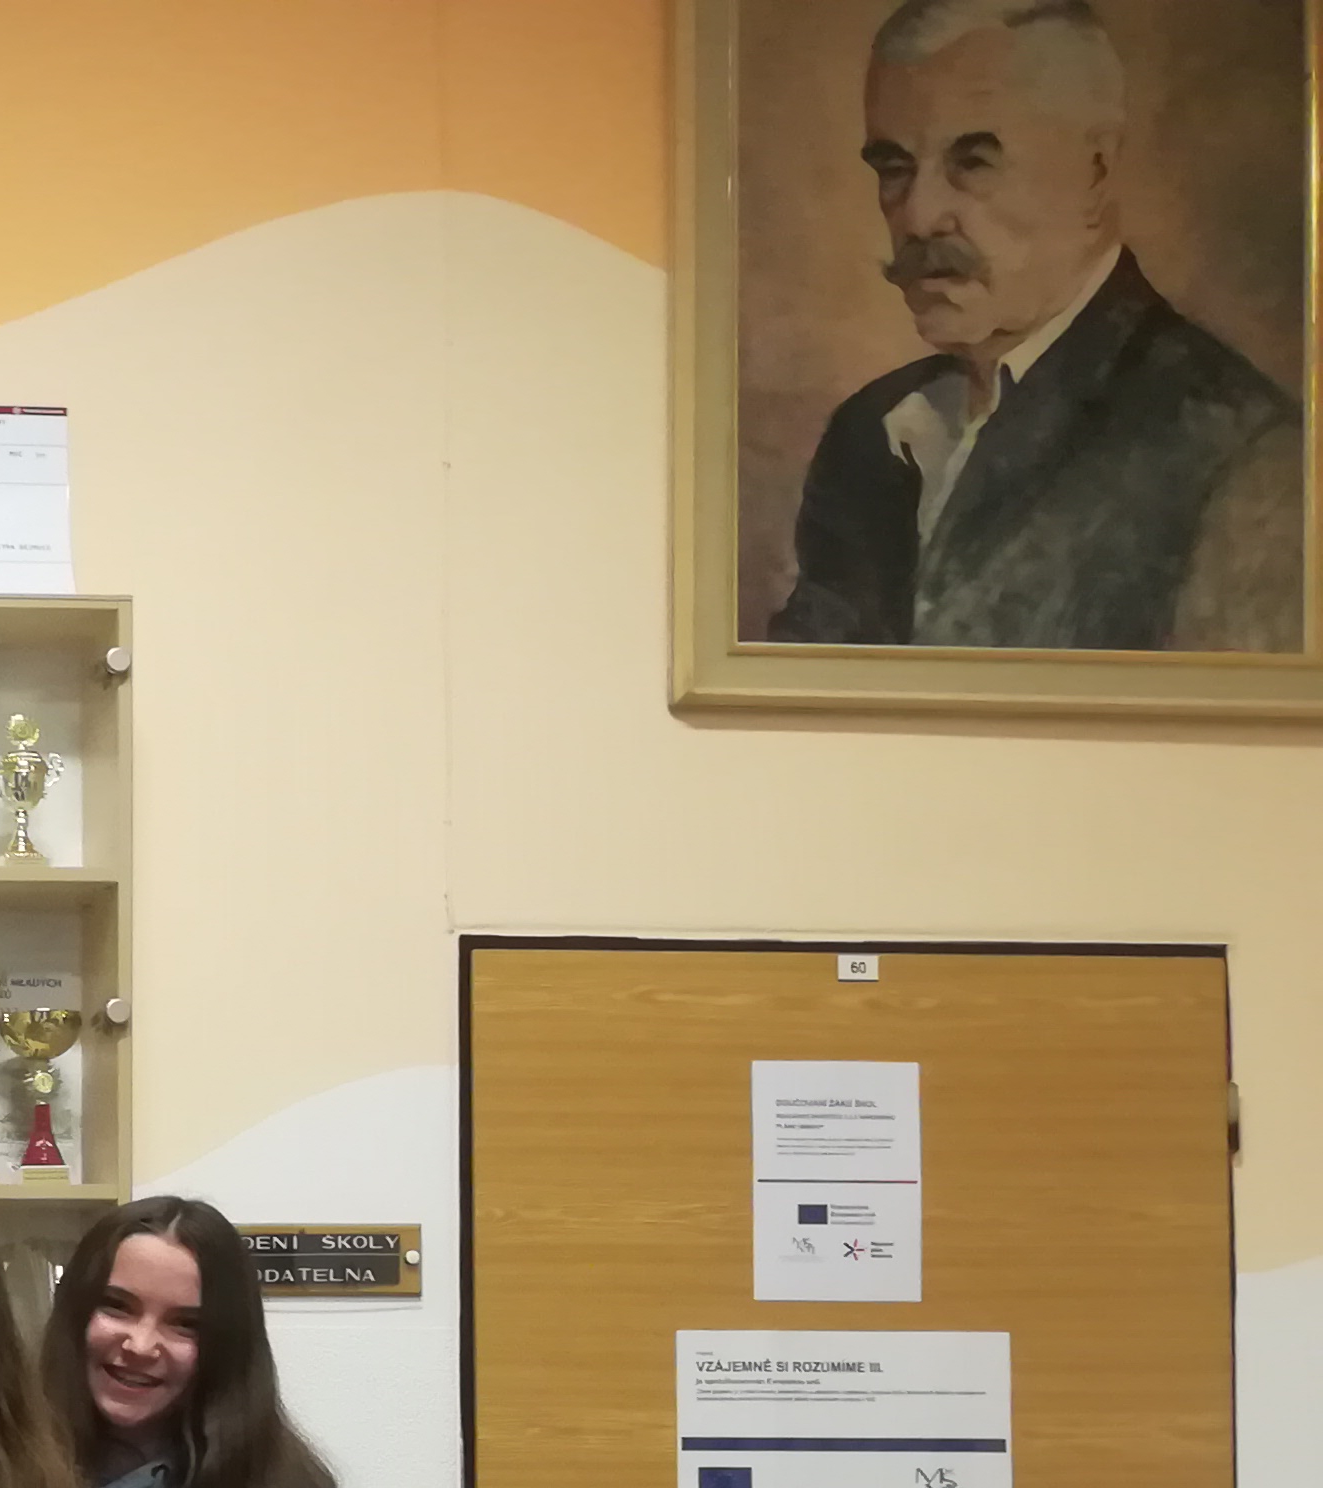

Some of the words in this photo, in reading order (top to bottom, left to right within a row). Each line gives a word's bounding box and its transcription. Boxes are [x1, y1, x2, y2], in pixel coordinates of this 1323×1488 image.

[850, 961, 866, 974] 60
[257, 1268, 376, 1282] DATELNA
[696, 1359, 772, 1372] VZÁJEMNĚ
[776, 1361, 788, 1372] SI
[792, 1360, 865, 1373] ROZUMÍME
